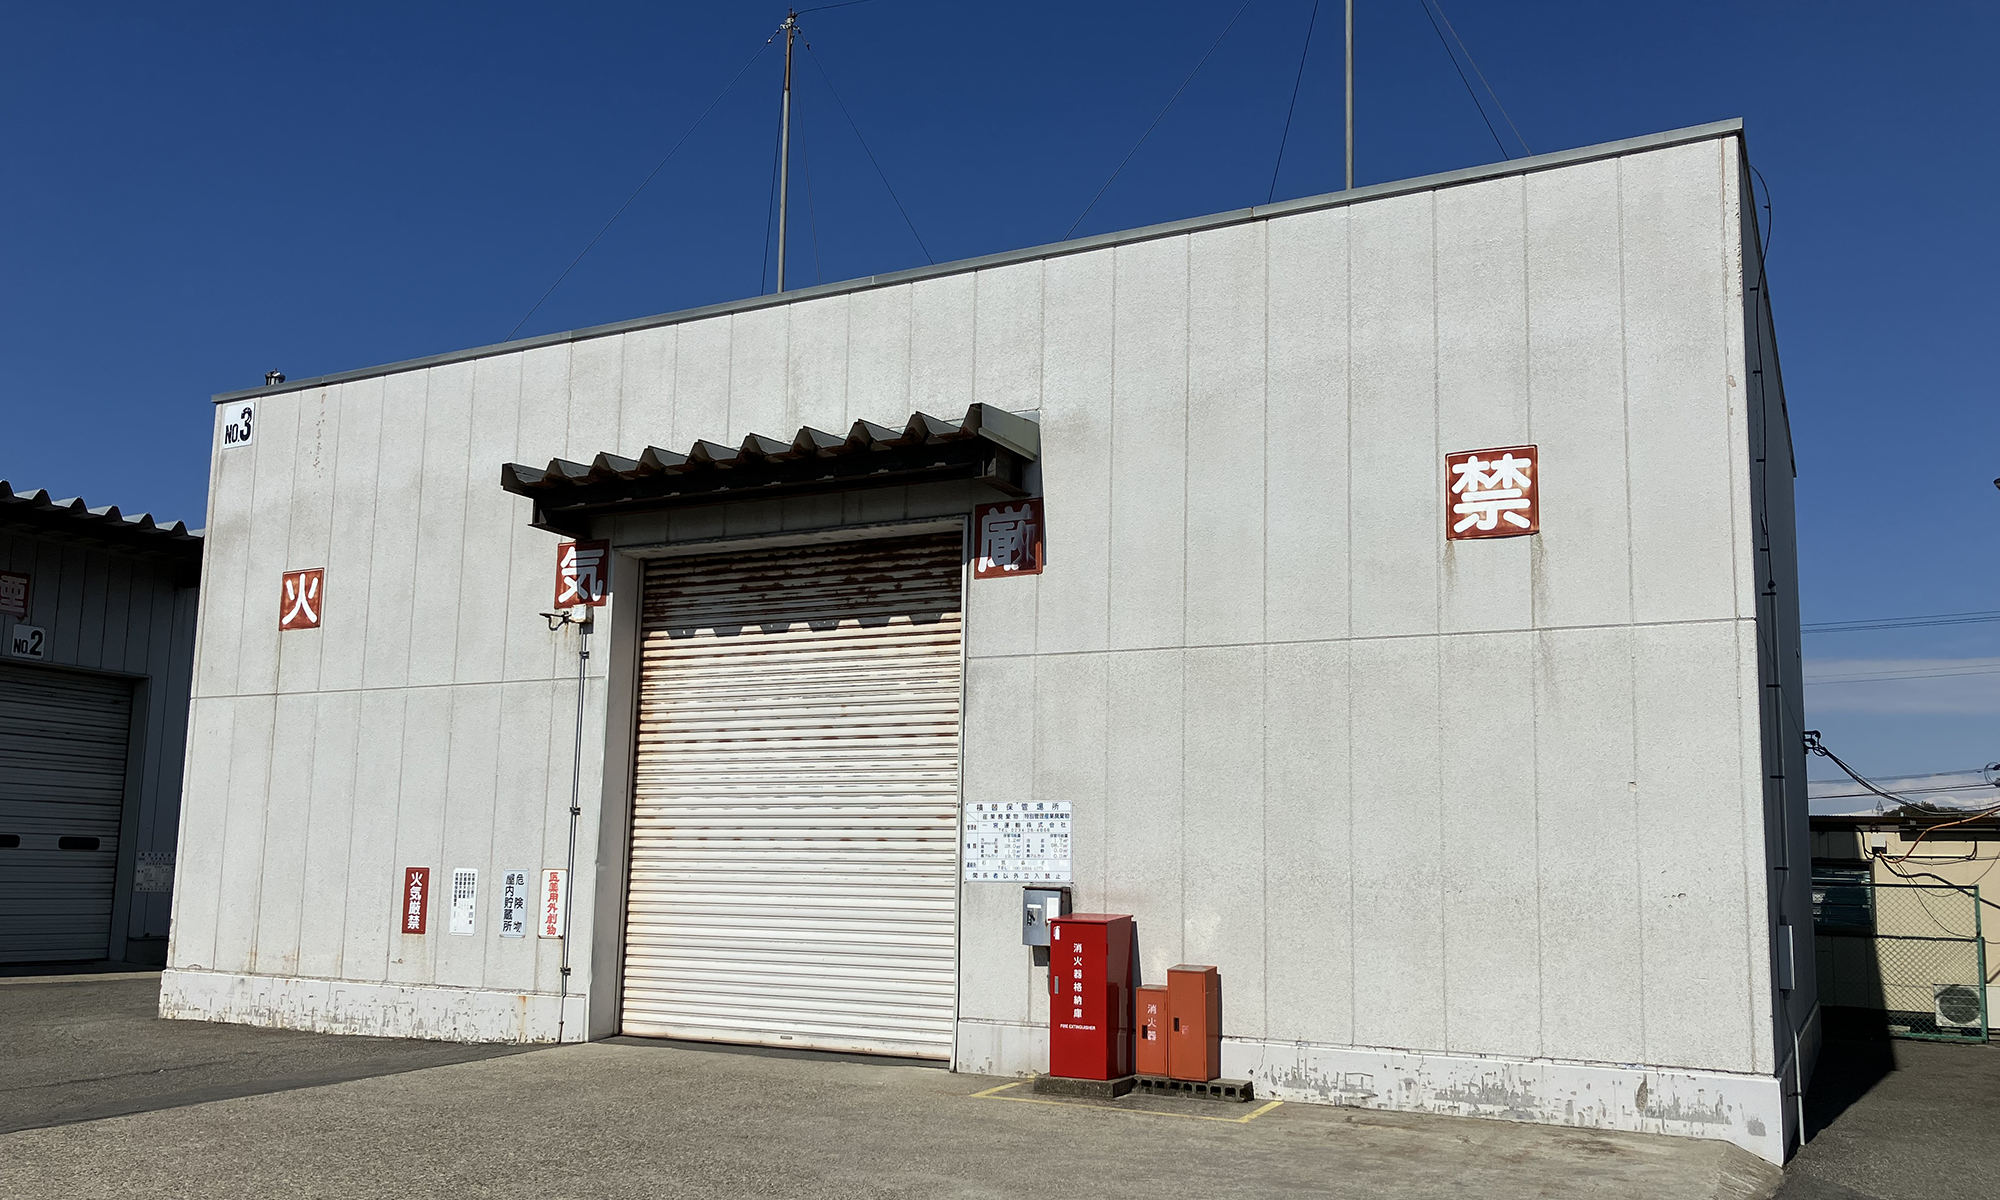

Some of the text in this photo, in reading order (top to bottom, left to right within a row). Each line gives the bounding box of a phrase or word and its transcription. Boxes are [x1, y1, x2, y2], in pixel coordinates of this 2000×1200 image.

[224, 407, 253, 444] NO.3
[281, 573, 319, 625] 火
[558, 546, 604, 603] 気
[1451, 452, 1532, 534] 禁
[13, 630, 43, 656] NO.2
[407, 871, 423, 930] 火気厳禁
[545, 872, 560, 936] 医薬用外劇物
[1073, 942, 1083, 1019] 消火器格納庫
[1147, 1003, 1157, 1041] 消火器
